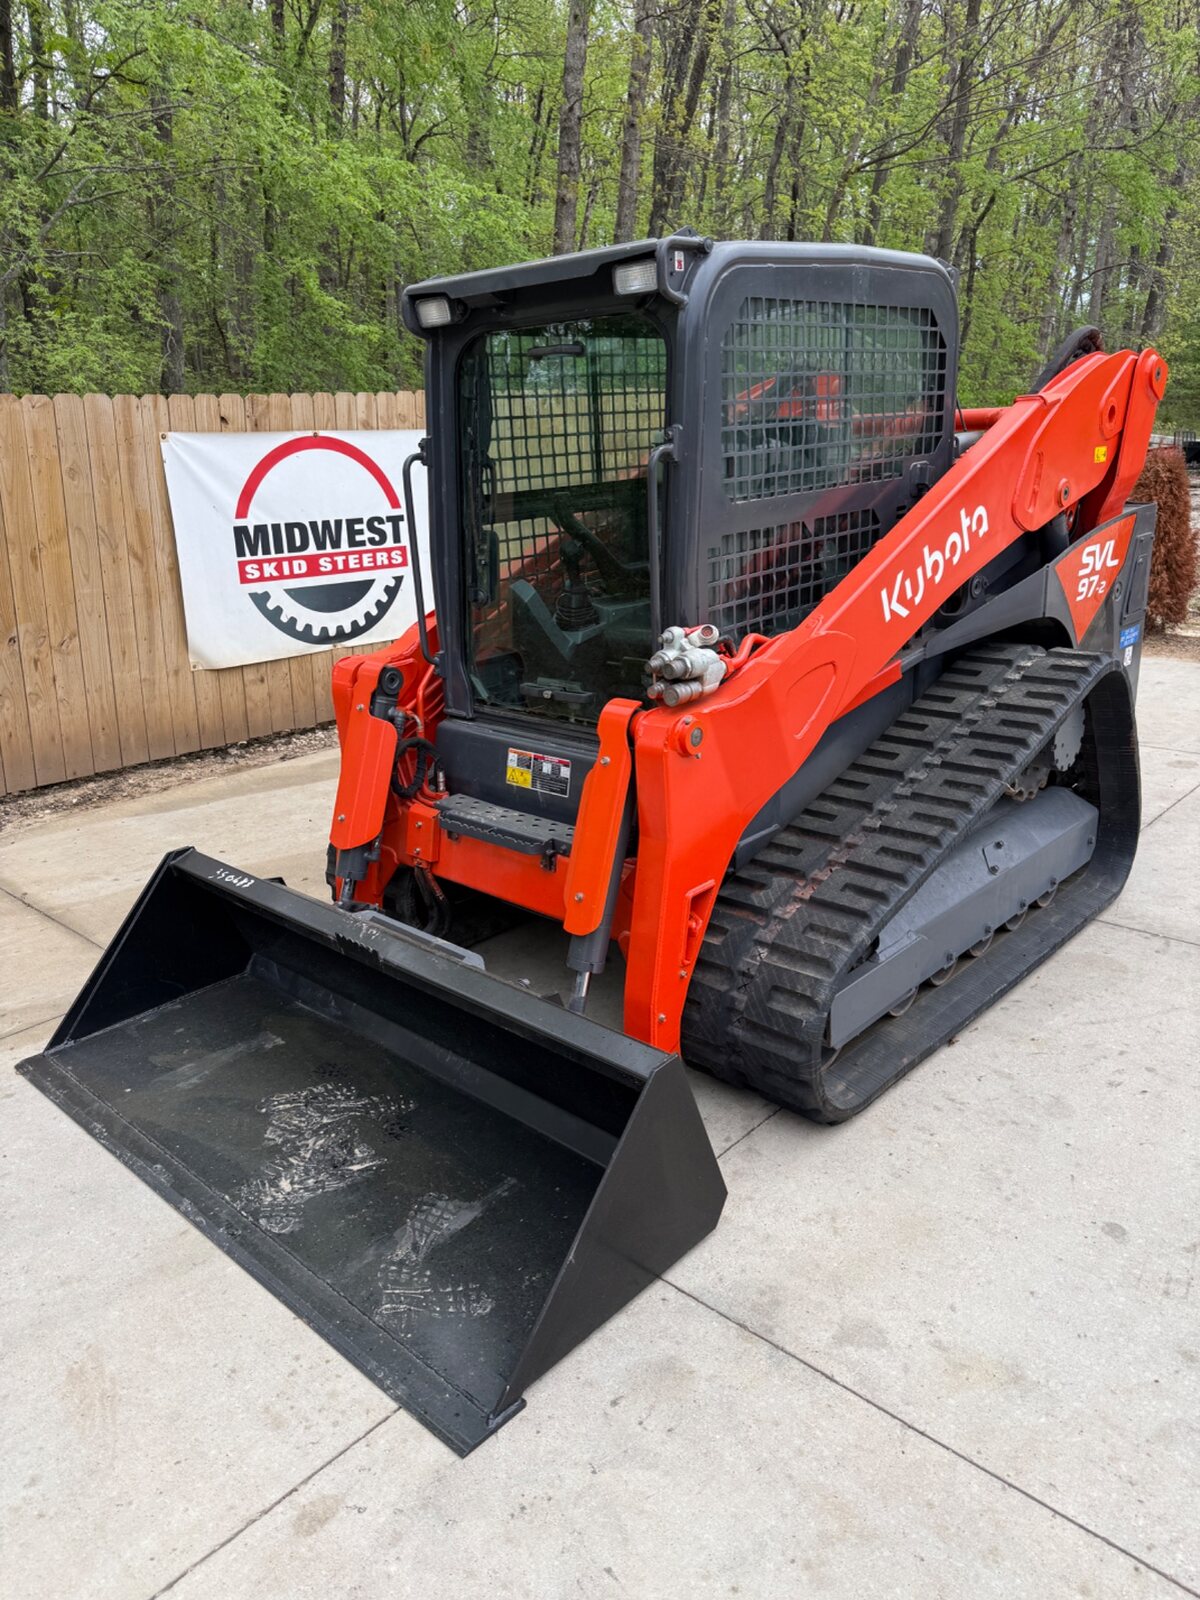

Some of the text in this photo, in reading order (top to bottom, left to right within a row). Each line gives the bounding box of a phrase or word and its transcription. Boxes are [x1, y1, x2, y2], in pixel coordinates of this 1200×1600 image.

[233, 514, 405, 558] MIDWEST
[244, 550, 404, 579] SKID STEERS
[880, 505, 989, 623] Kubota
[1077, 539, 1120, 577] SVL
[1075, 574, 1107, 602] 97-2
